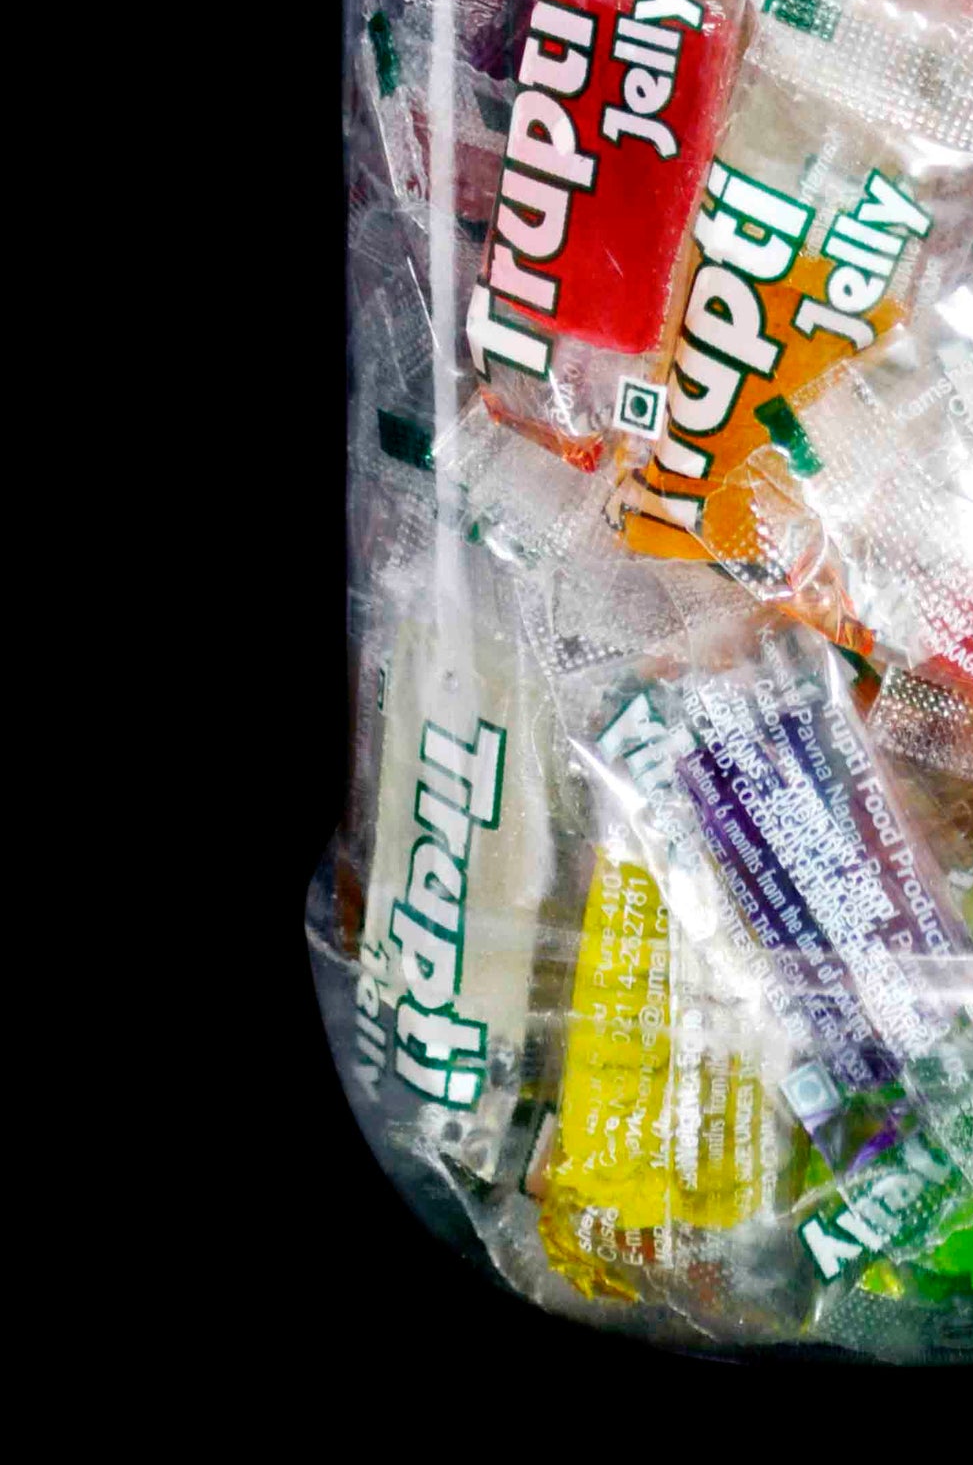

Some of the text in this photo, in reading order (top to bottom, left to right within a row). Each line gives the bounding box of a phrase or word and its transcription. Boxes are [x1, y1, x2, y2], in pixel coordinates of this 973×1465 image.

[788, 167, 933, 349] Jelly
[787, 704, 836, 782] Pavna
[684, 752, 728, 807] before
[712, 802, 734, 821] 6
[852, 774, 908, 848] Food
[722, 814, 769, 876] months
[388, 721, 506, 1113] Trupti
[719, 859, 761, 917] UNDER
[749, 913, 780, 949] THE
[754, 866, 791, 910] from
[777, 903, 809, 936] the
[793, 928, 832, 971] date
[815, 960, 843, 986] of
